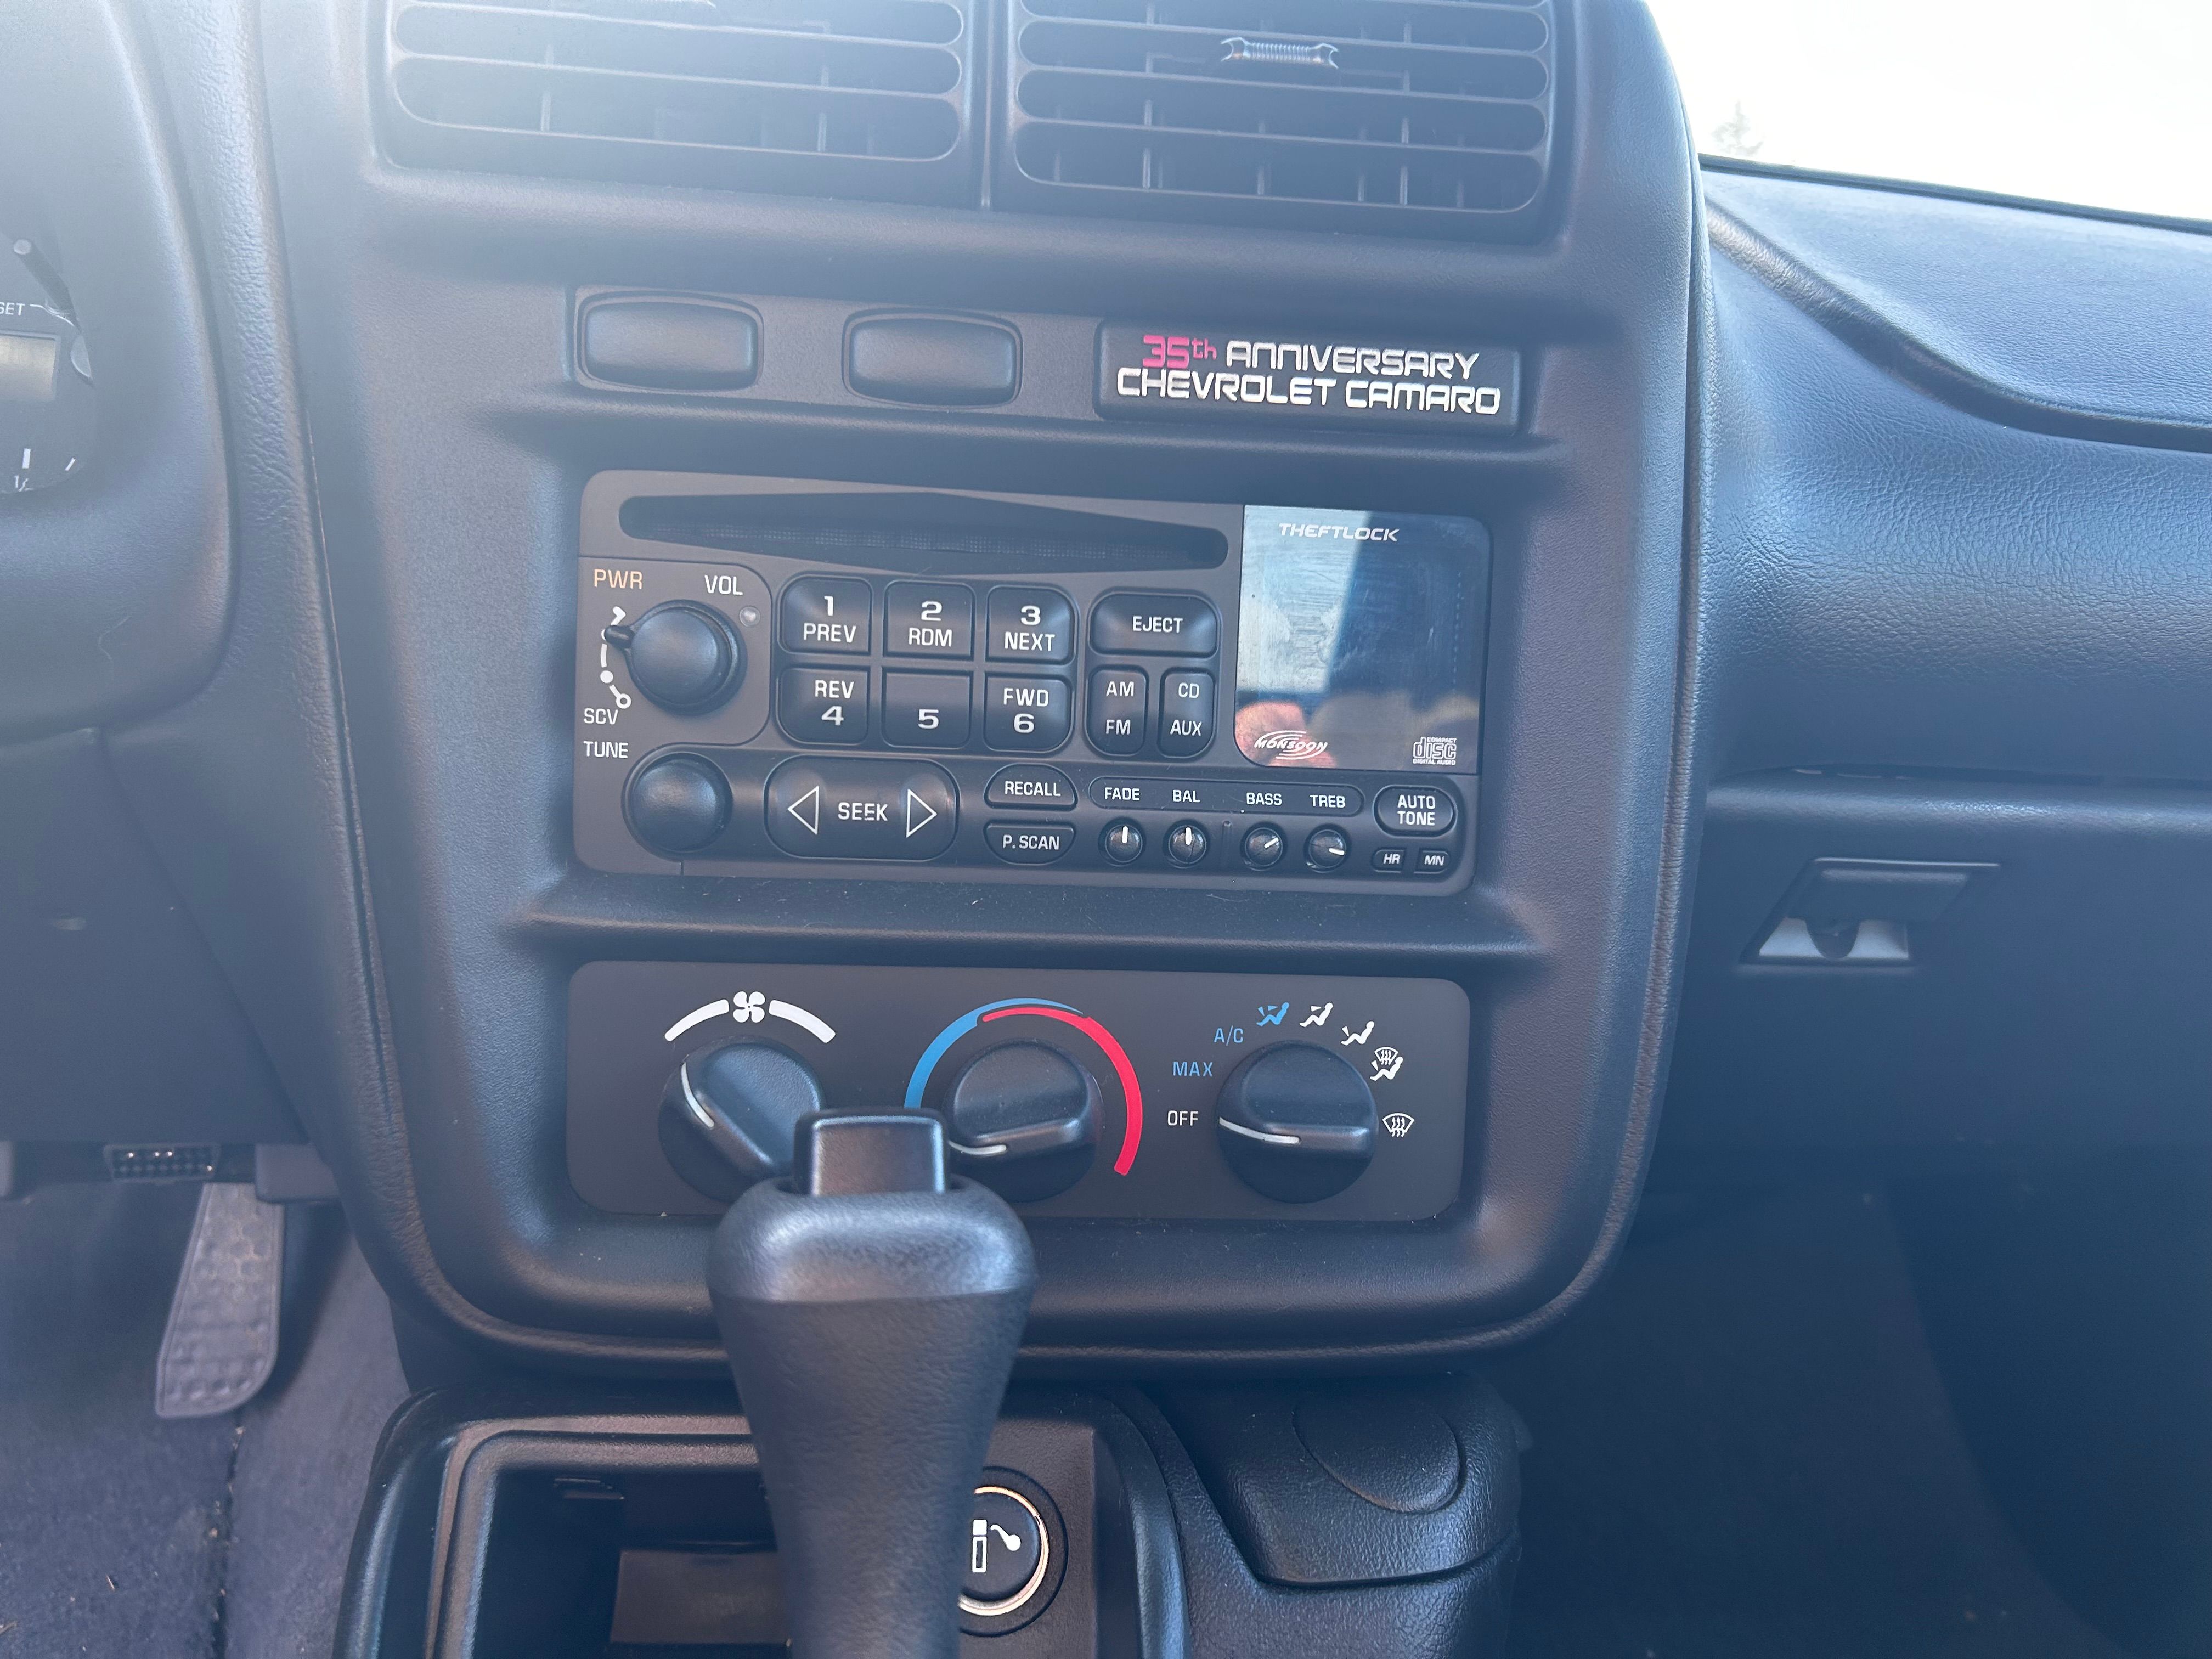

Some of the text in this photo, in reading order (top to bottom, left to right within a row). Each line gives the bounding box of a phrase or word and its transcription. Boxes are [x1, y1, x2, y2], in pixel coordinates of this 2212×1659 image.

[1142, 335, 1480, 380] 35th ANNIVERSARY
[1117, 367, 1500, 414] CHEVROLET CAMARO
[1279, 523, 1400, 542] THEFTLOCK
[594, 569, 643, 589] PWR
[704, 574, 743, 595] VOL
[823, 596, 834, 616] 1
[921, 601, 943, 622] 2
[1020, 605, 1041, 625] 3
[803, 623, 856, 643] PREV
[1132, 616, 1183, 633] EJECT
[909, 628, 952, 647] RDM
[1005, 632, 1055, 652] NEXT
[815, 680, 854, 699] REV
[1003, 688, 1048, 707] FWD
[1106, 681, 1135, 697] AM
[1178, 682, 1199, 698] CD
[584, 708, 618, 725] SCV
[821, 705, 844, 726] 4
[918, 709, 939, 729] 5
[1013, 713, 1035, 733] 6
[1105, 720, 1131, 735] FM
[1170, 720, 1202, 736] AUX
[583, 741, 628, 759] TUNE
[1005, 781, 1061, 797] RECALL
[1105, 787, 1140, 800] FADE
[1172, 789, 1200, 803] BAL
[1246, 792, 1282, 806] BASS
[1310, 794, 1346, 809] TREB
[1397, 794, 1436, 810] AUTO
[838, 802, 888, 822] SEEK
[1397, 810, 1435, 826] TONE
[1383, 853, 1401, 864] HR
[1424, 855, 1444, 866] MN
[1214, 1025, 1244, 1046] A/C
[1172, 1062, 1212, 1077] MAX
[1167, 1110, 1199, 1126] OFF
